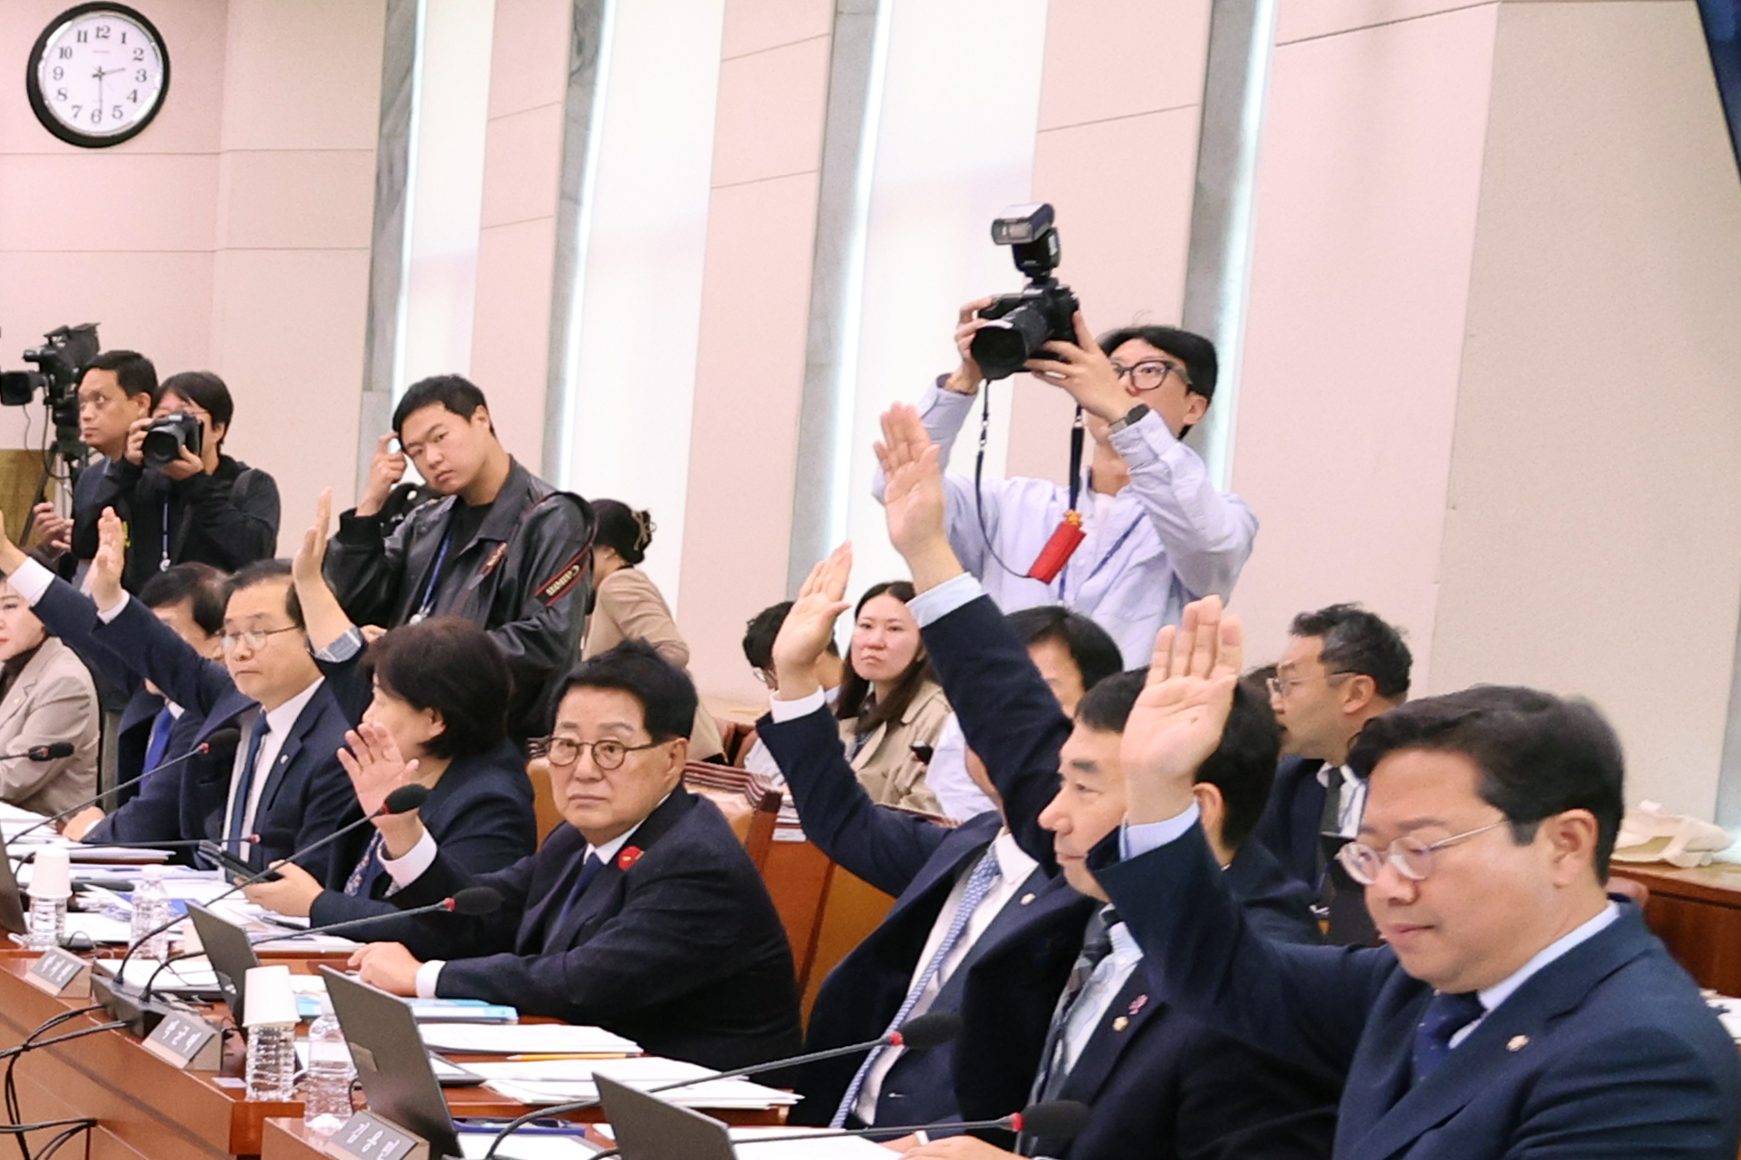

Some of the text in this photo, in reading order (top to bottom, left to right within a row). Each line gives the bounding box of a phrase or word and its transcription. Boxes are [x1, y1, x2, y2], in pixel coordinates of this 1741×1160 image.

[76, 30, 88, 43] 11
[95, 25, 111, 39] 12
[120, 32, 127, 44] 1
[58, 46, 72, 59] 10
[132, 48, 144, 61] 2
[53, 66, 64, 80] 9
[135, 69, 147, 82] 3
[56, 87, 68, 101] 8
[126, 88, 138, 103] 4
[71, 105, 83, 119] 7
[91, 109, 103, 124] 6
[111, 105, 123, 119] 5
